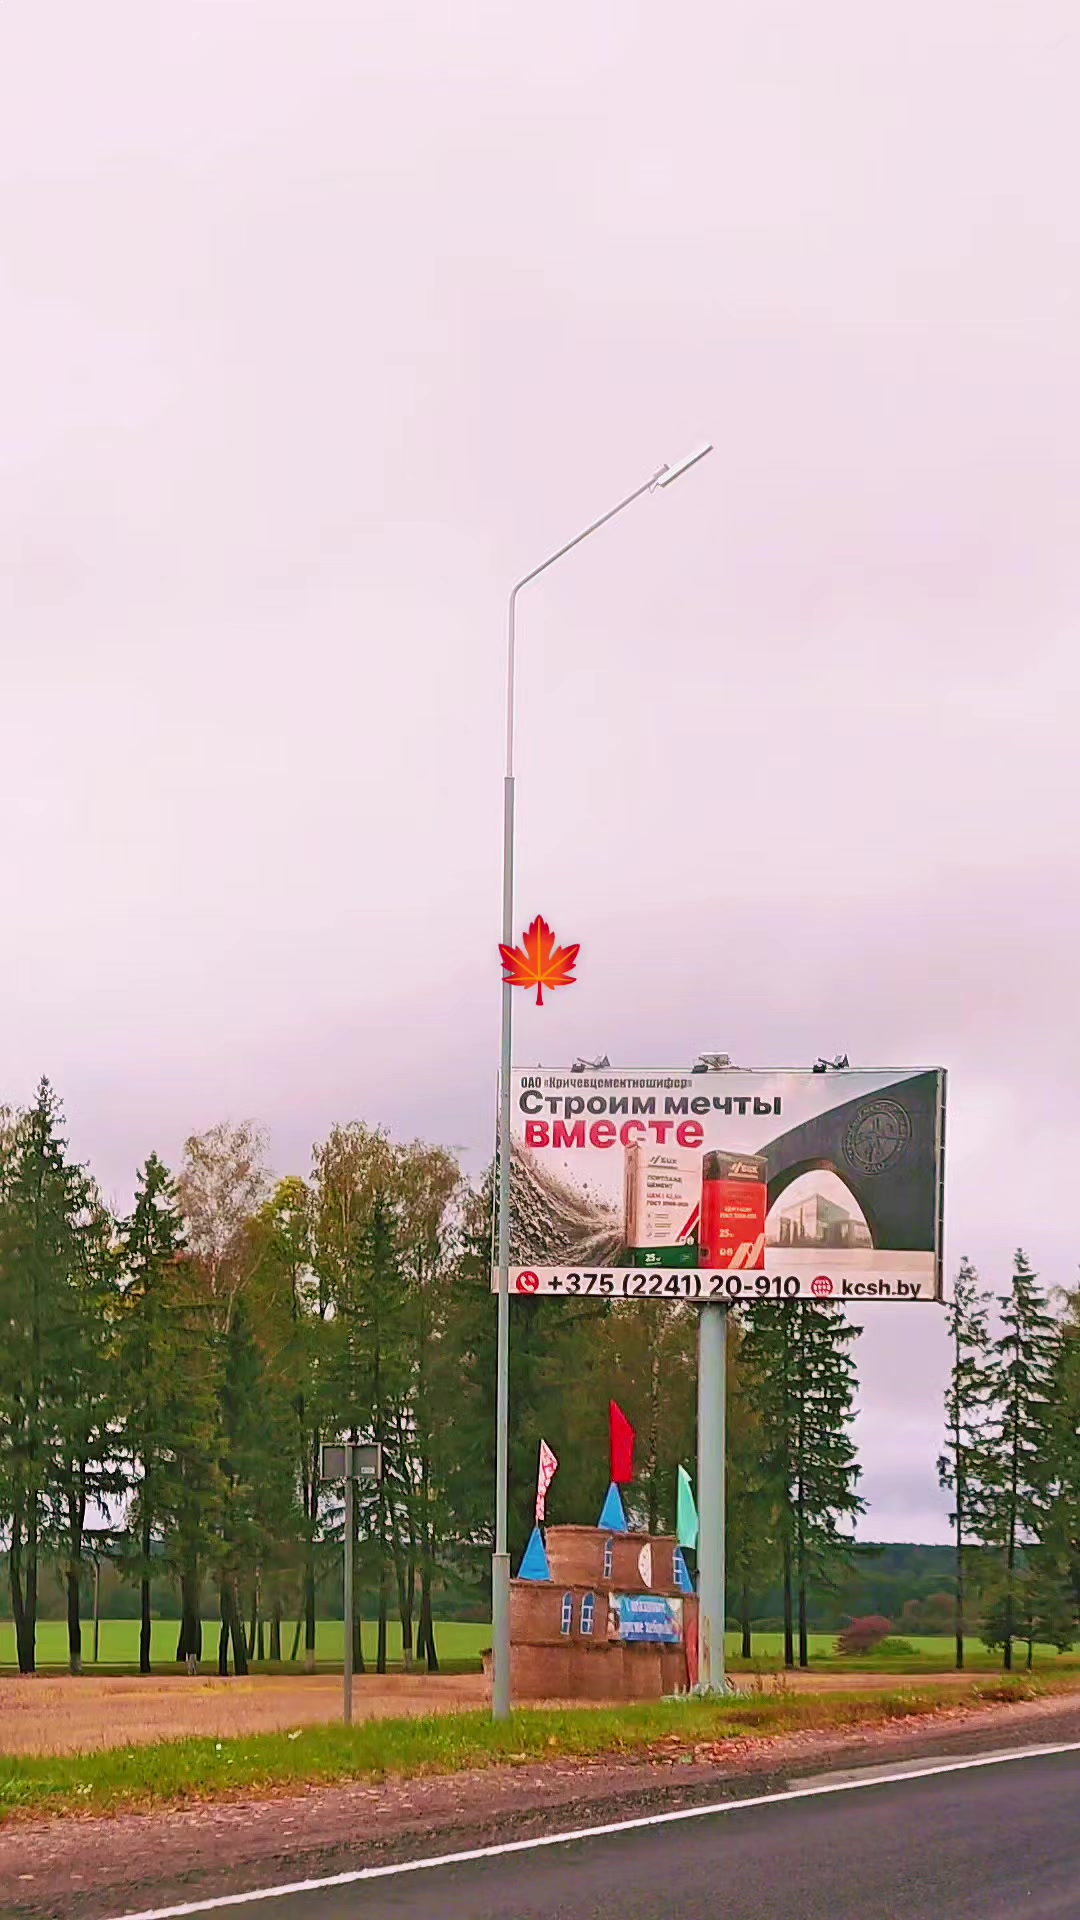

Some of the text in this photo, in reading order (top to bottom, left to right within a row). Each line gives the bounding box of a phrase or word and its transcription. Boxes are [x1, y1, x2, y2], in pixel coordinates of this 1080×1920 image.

[520, 1076, 541, 1089] ОАО
[519, 1089, 782, 1119] Строим мечты
[525, 1119, 704, 1149] вместе
[548, 1272, 801, 1297] +375 (2241) 20-910
[842, 1279, 922, 1299] kcsh.by
